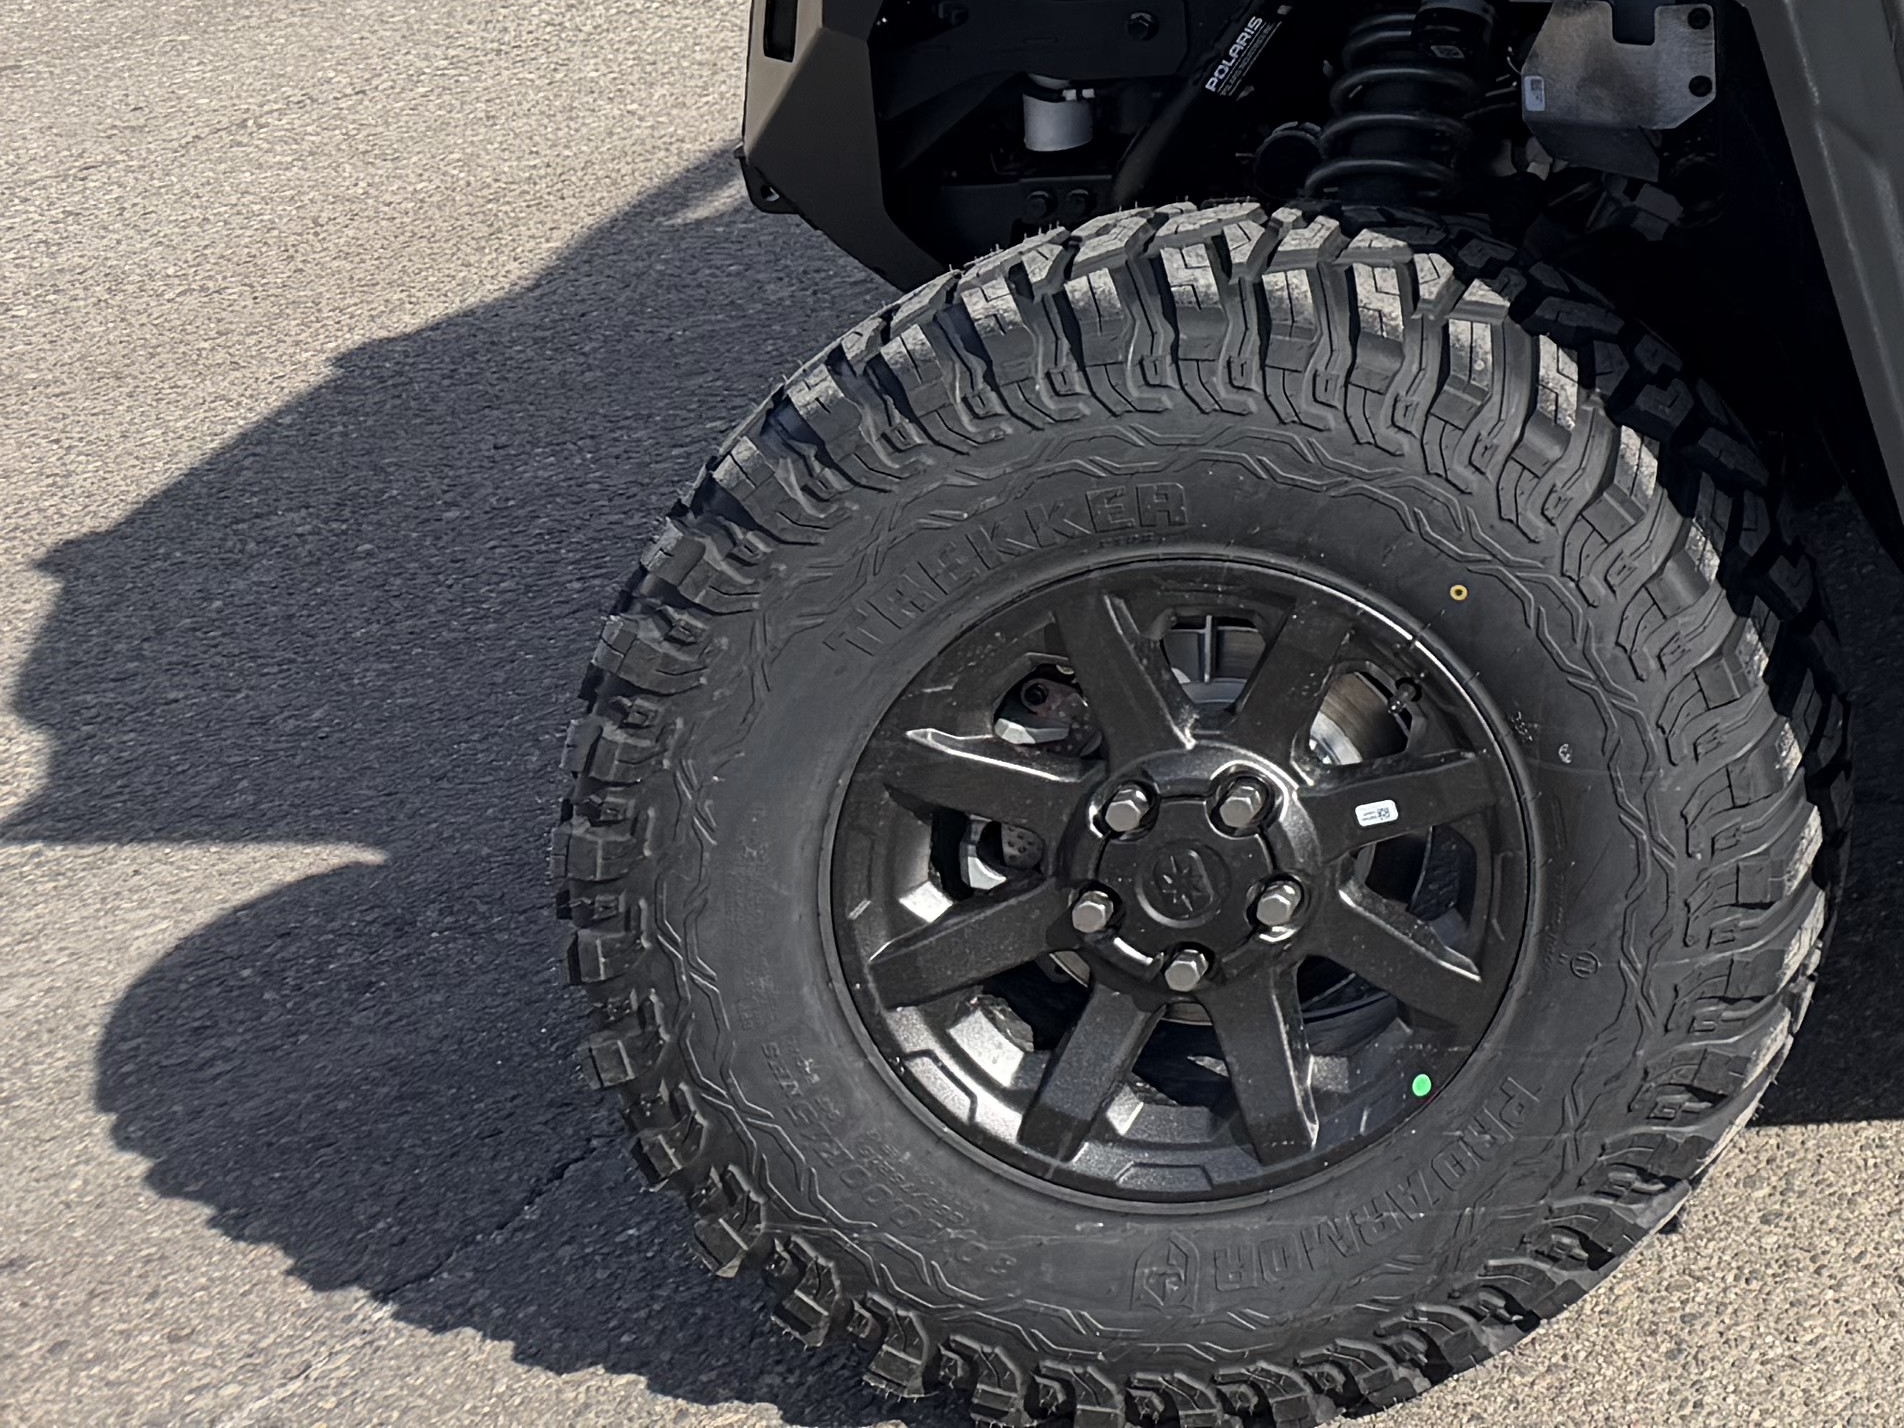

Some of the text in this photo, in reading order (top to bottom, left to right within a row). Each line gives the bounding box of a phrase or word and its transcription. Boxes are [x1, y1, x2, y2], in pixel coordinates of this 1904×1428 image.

[1204, 15, 1264, 94] POLARIS
[827, 477, 1189, 660] TREKKER
[1213, 1074, 1542, 1290] PRO ARMOR
